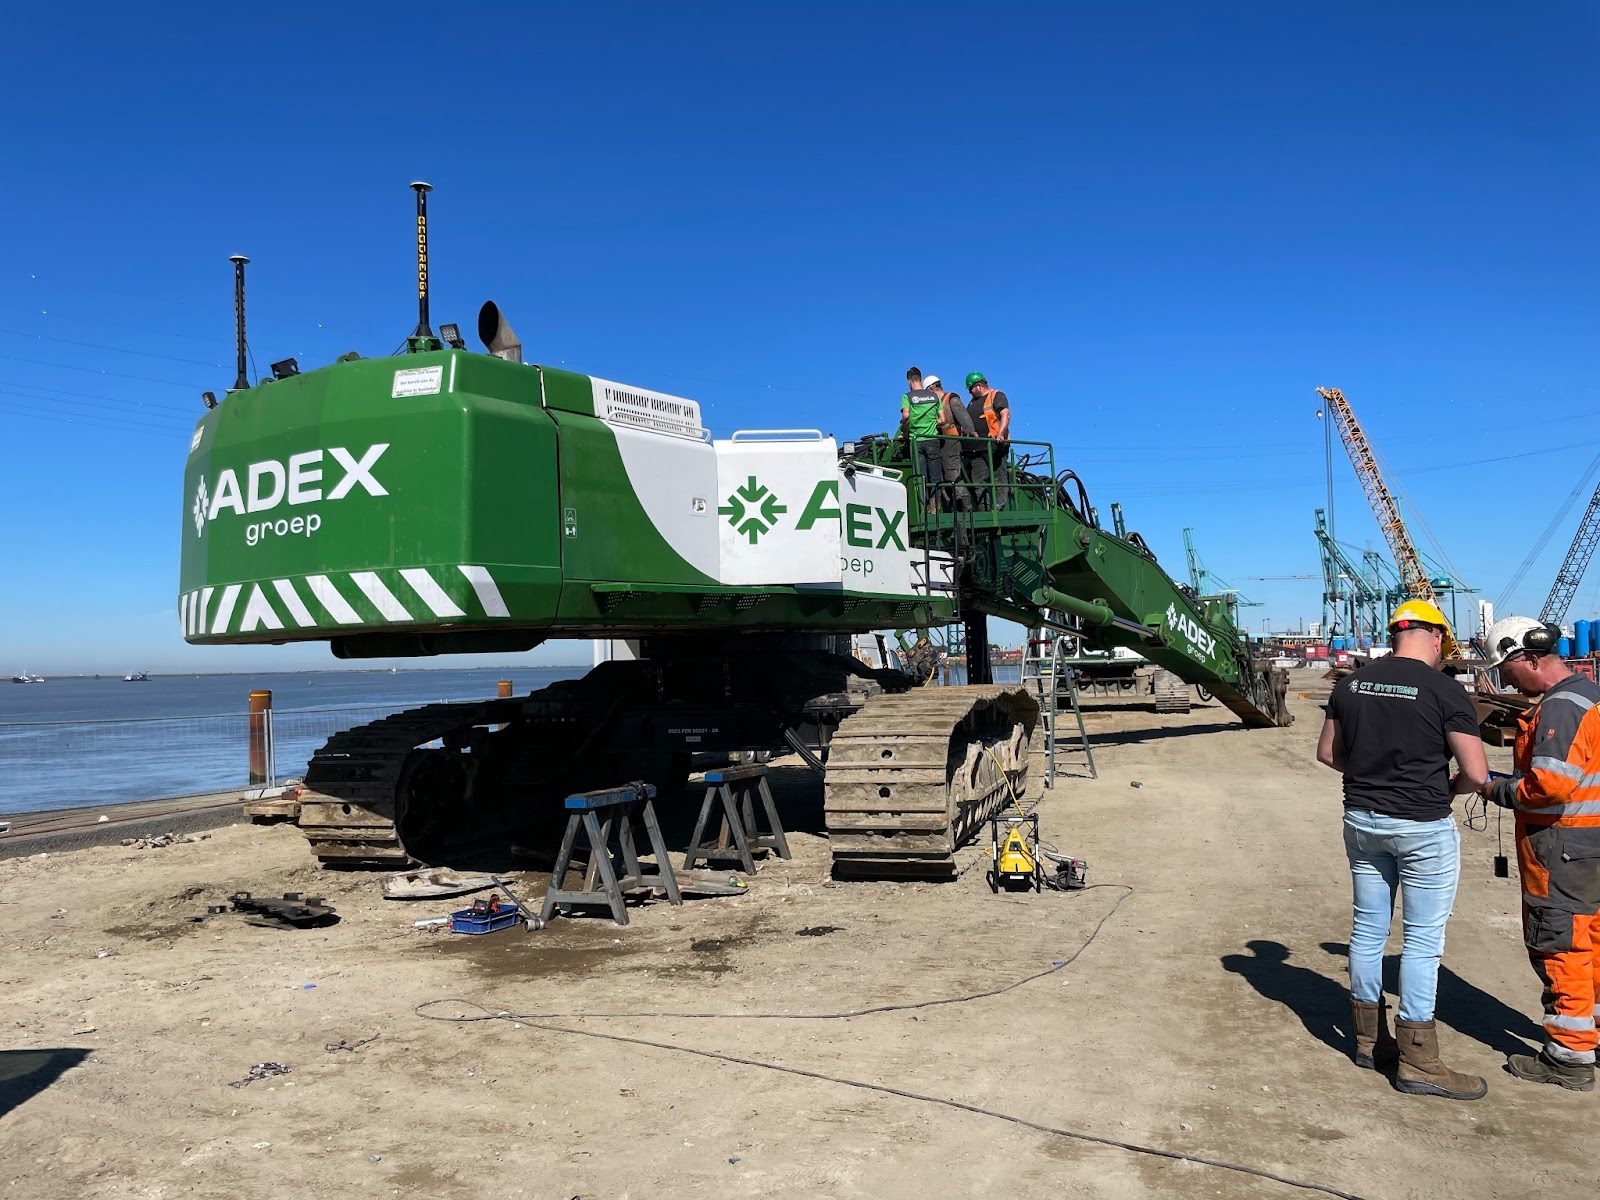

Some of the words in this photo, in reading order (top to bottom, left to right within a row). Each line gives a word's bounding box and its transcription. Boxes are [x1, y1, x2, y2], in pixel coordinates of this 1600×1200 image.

[208, 443, 390, 520] ADEX
[246, 514, 321, 546] groep
[794, 480, 907, 551] AEX
[1177, 612, 1216, 660] ADEX
[1187, 644, 1206, 663] groep
[1373, 683, 1418, 696] SYSTEMS
